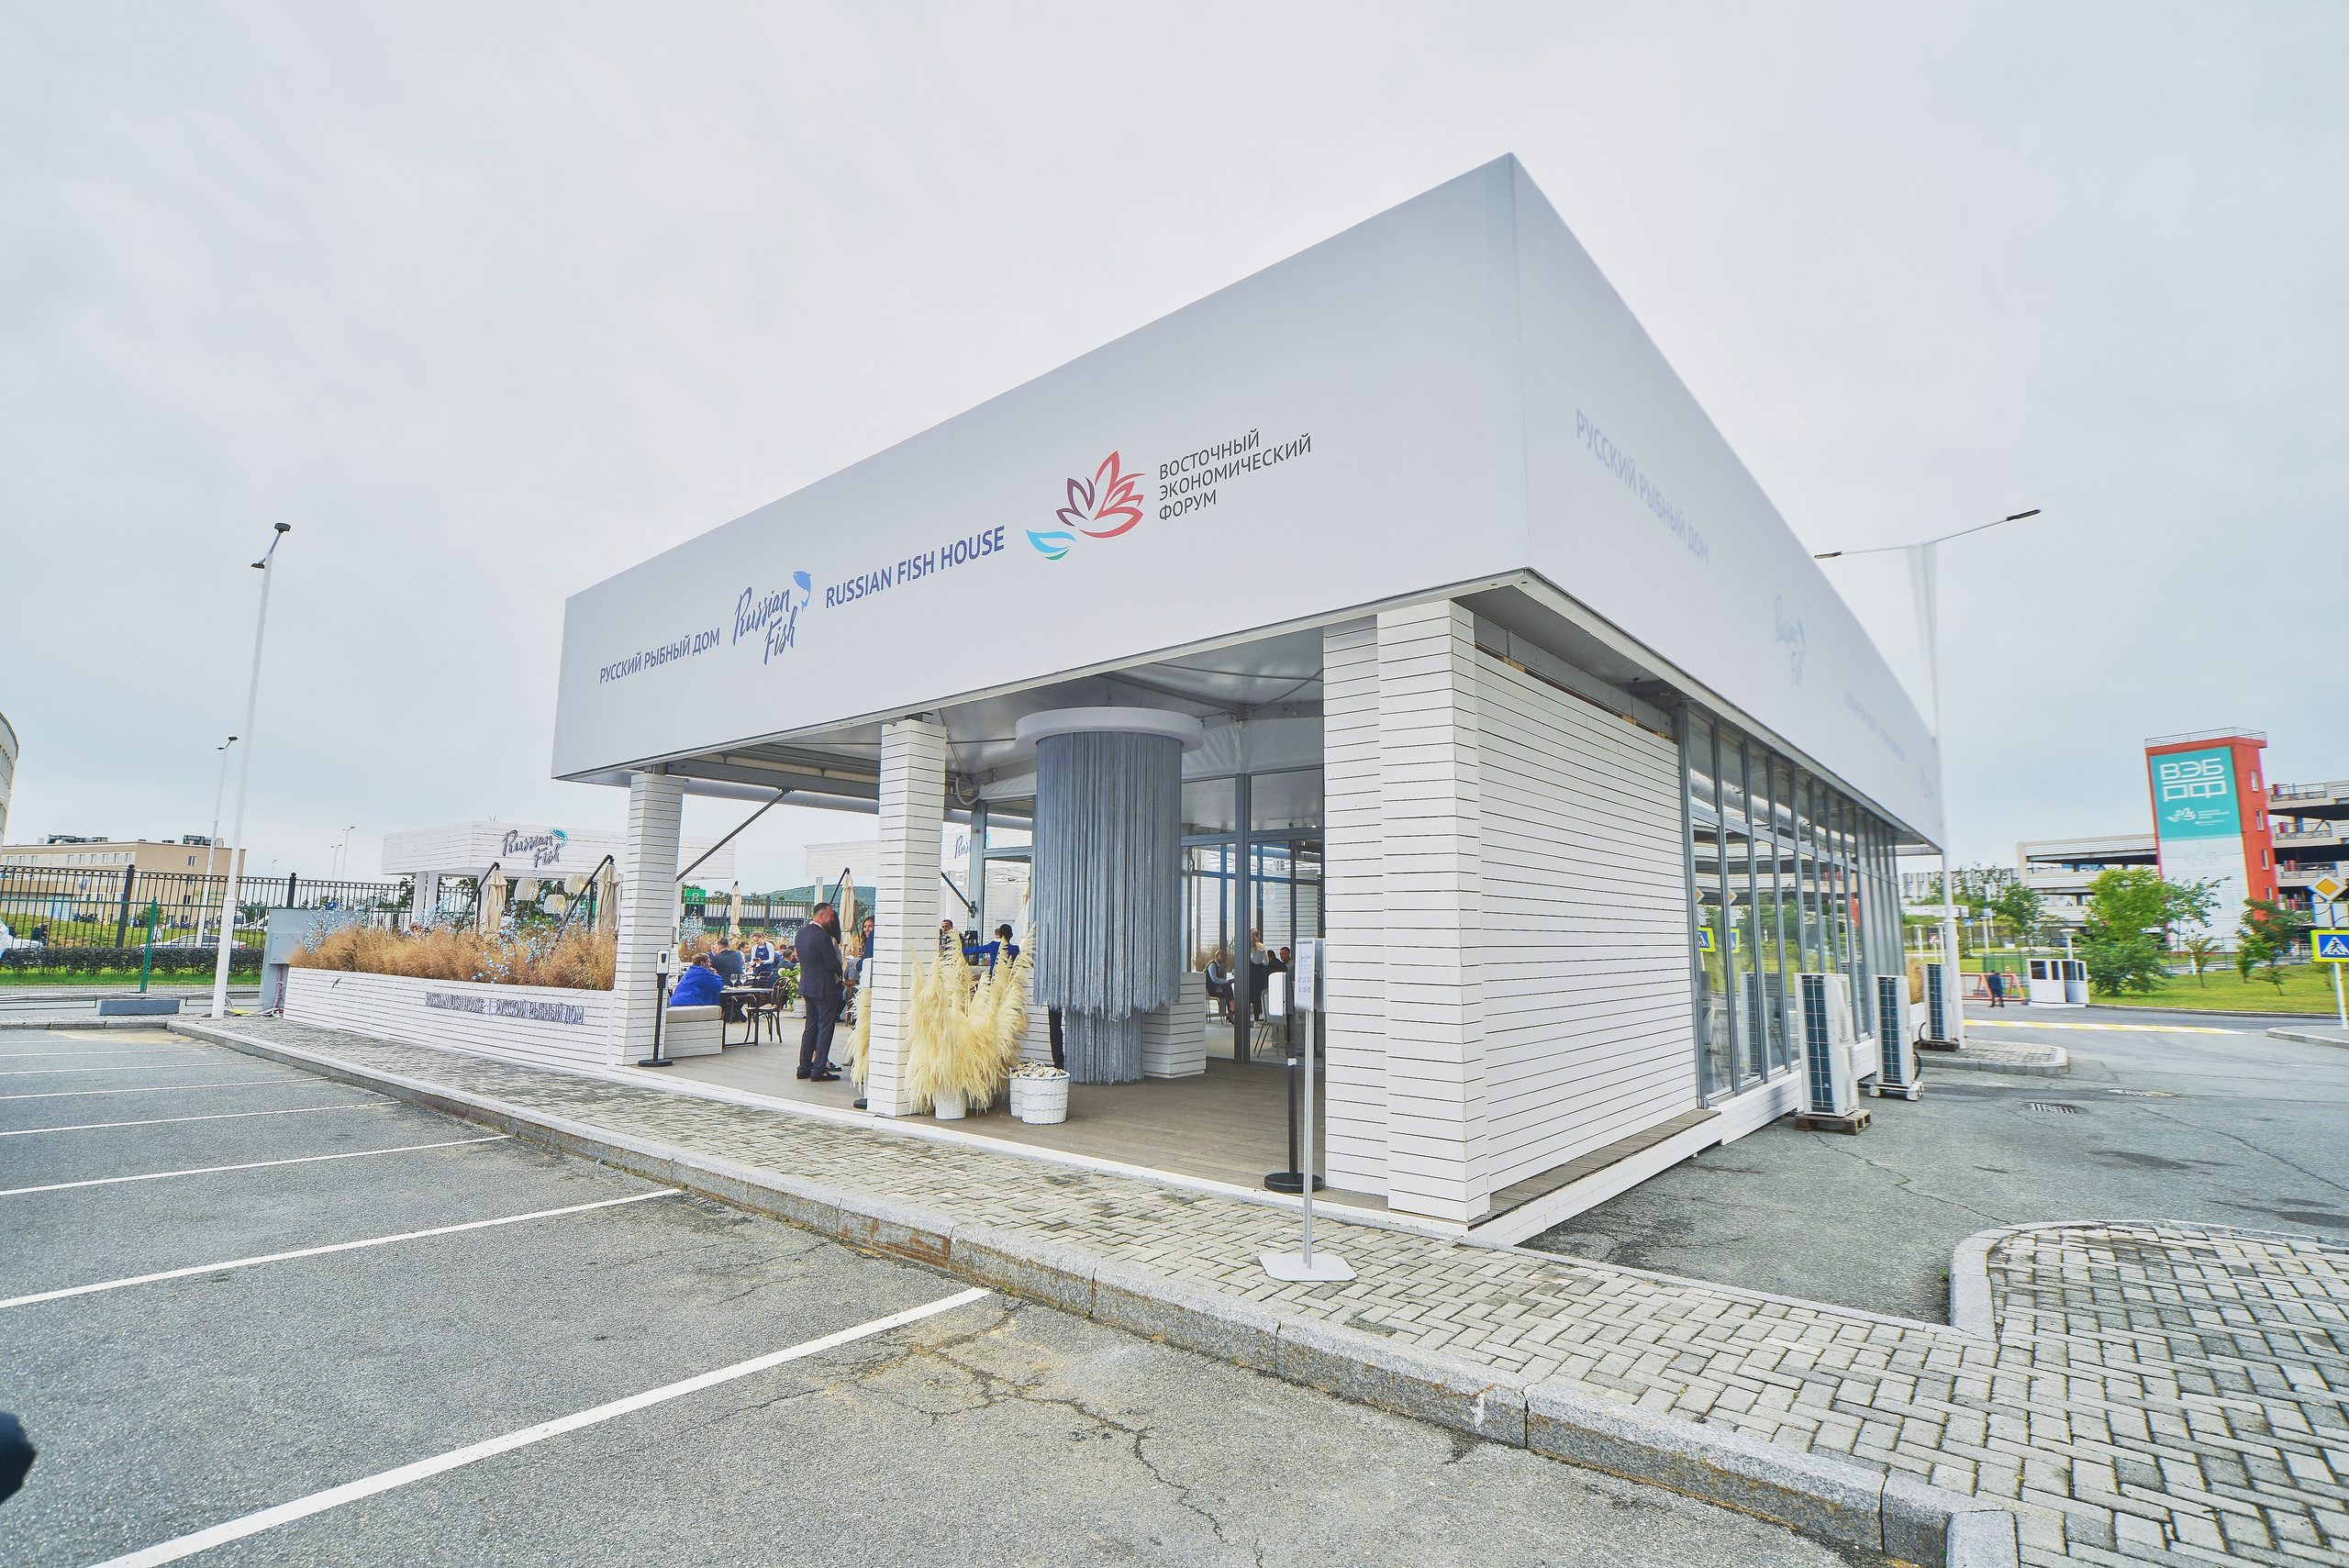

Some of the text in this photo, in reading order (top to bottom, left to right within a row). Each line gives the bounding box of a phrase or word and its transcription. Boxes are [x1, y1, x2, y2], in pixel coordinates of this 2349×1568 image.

[1159, 428, 1260, 481] ВОСТОЧНЫЙ
[1159, 432, 1311, 501] ЭКОНОМИЧЕСКИЙ
[1159, 489, 1217, 521] ФОРУМ
[1576, 408, 1709, 565] РУССКИЙ РЫБНЫЙ ДОМ
[826, 525, 1005, 609] RUSSIAN FISH HOUSE
[732, 586, 790, 646] Russian
[763, 606, 798, 665] Fish
[599, 628, 720, 684] РУССКИЙ РЫБНЫЙ ДОМ
[2160, 758, 2224, 780] ВЭБ
[2163, 780, 2227, 802] РФ
[503, 829, 553, 856] Russian
[534, 843, 561, 868] Fish
[495, 998, 584, 1025] РУССКИЙ РЫБНЫЙ ДОМ
